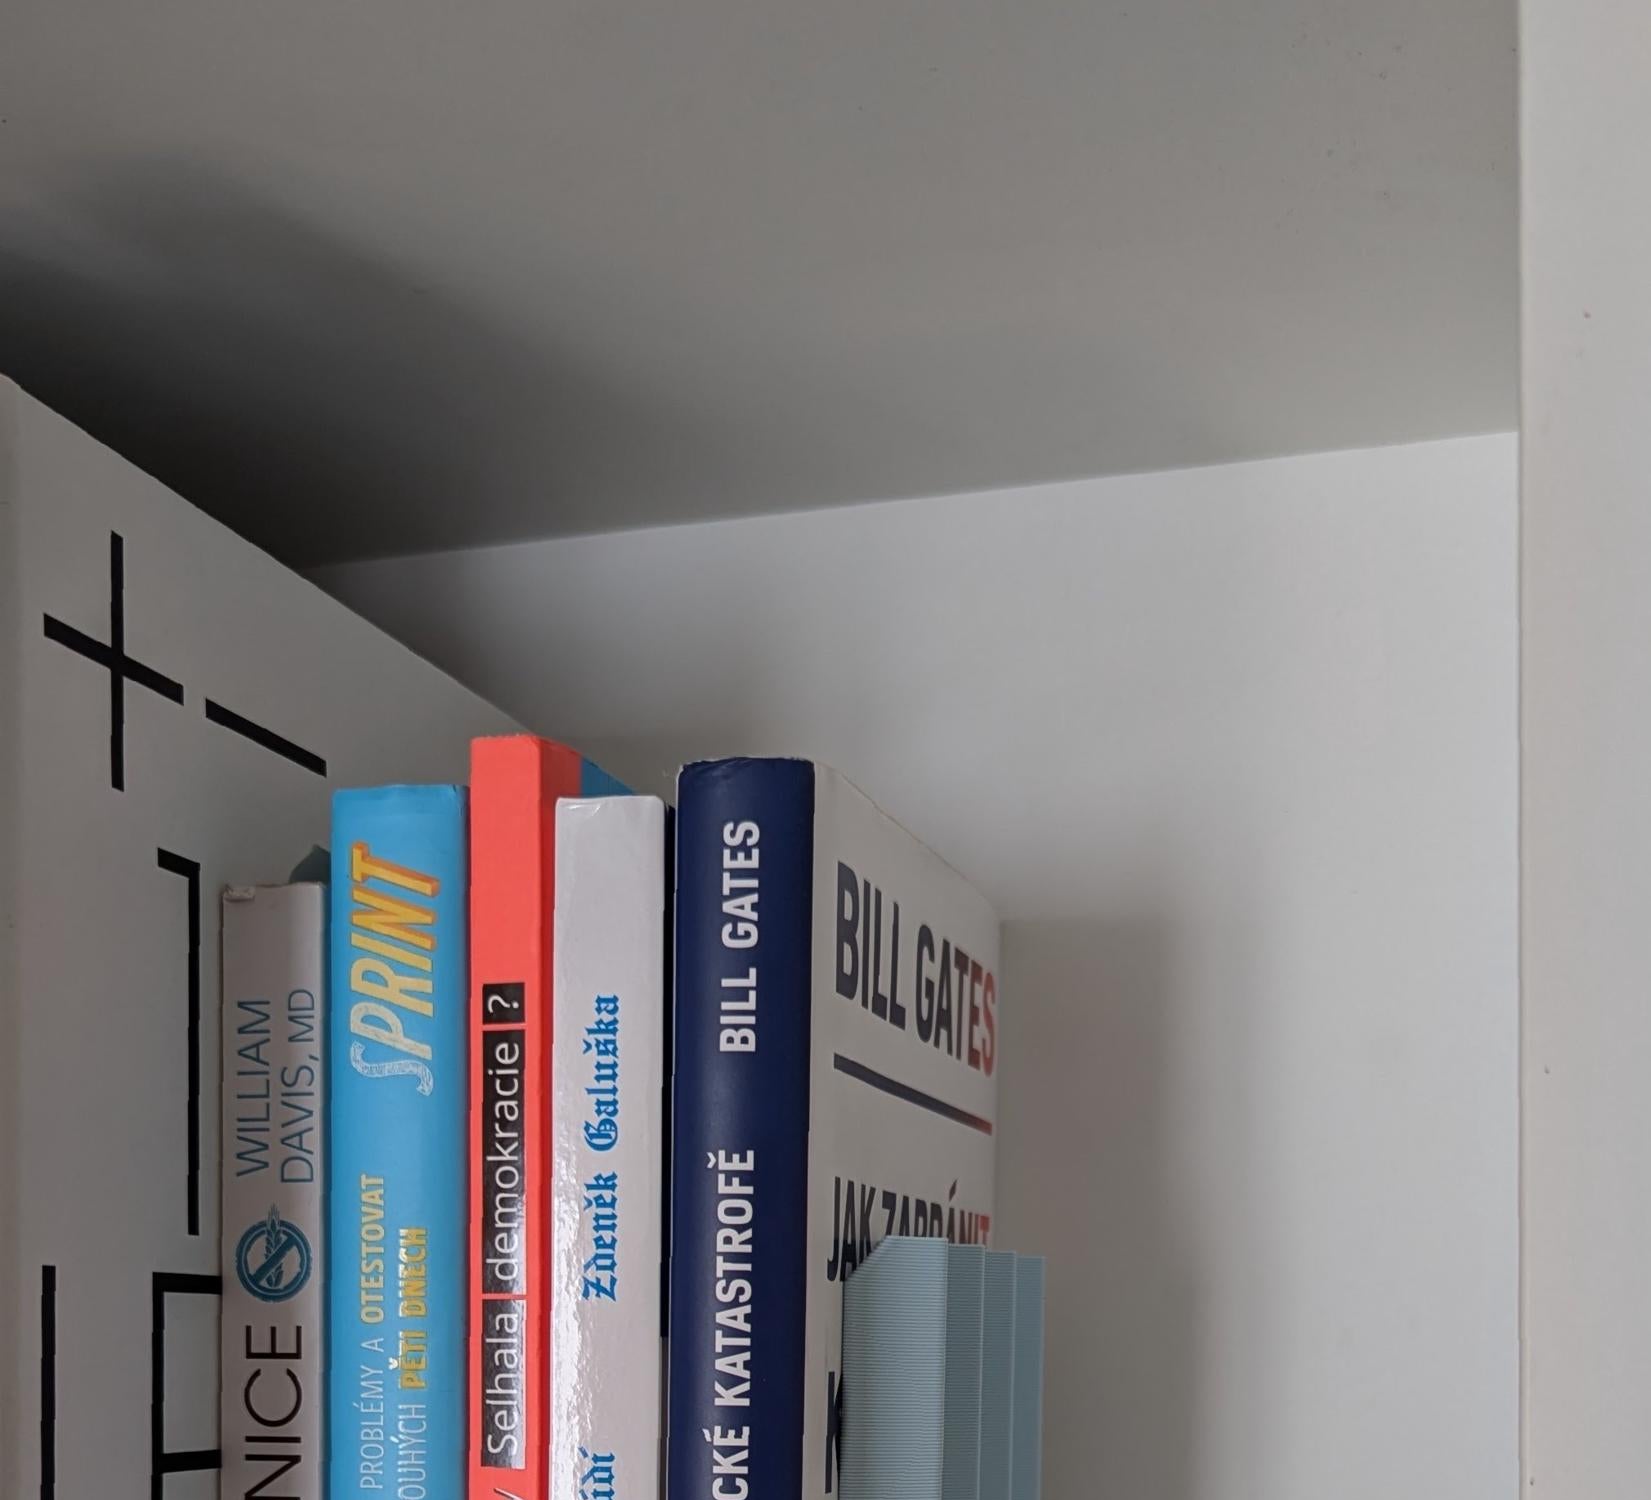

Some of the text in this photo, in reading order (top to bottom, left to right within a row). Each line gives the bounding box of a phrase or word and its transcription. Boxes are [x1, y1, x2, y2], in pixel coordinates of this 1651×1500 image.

[349, 841, 441, 1097] SPRINT
[719, 820, 760, 1053] BILL GATES
[835, 860, 996, 1078] BILL GATES
[236, 1000, 270, 1177] WILLIAM
[280, 988, 319, 1183] DAVIS, MD
[486, 1041, 520, 1281] demokracie
[581, 994, 619, 1302] Zdeněk Galuška
[360, 1173, 385, 1325] OTESTOVAT
[398, 1227, 428, 1318] DNECH
[706, 1149, 755, 1407] KATASTROFĚ
[827, 1176, 876, 1282] JAK
[353, 1365, 384, 1490] PROBLÉMY
[361, 1337, 384, 1353] A
[388, 1330, 427, 1390] PĚTI
[486, 1312, 520, 1456] Selhala
